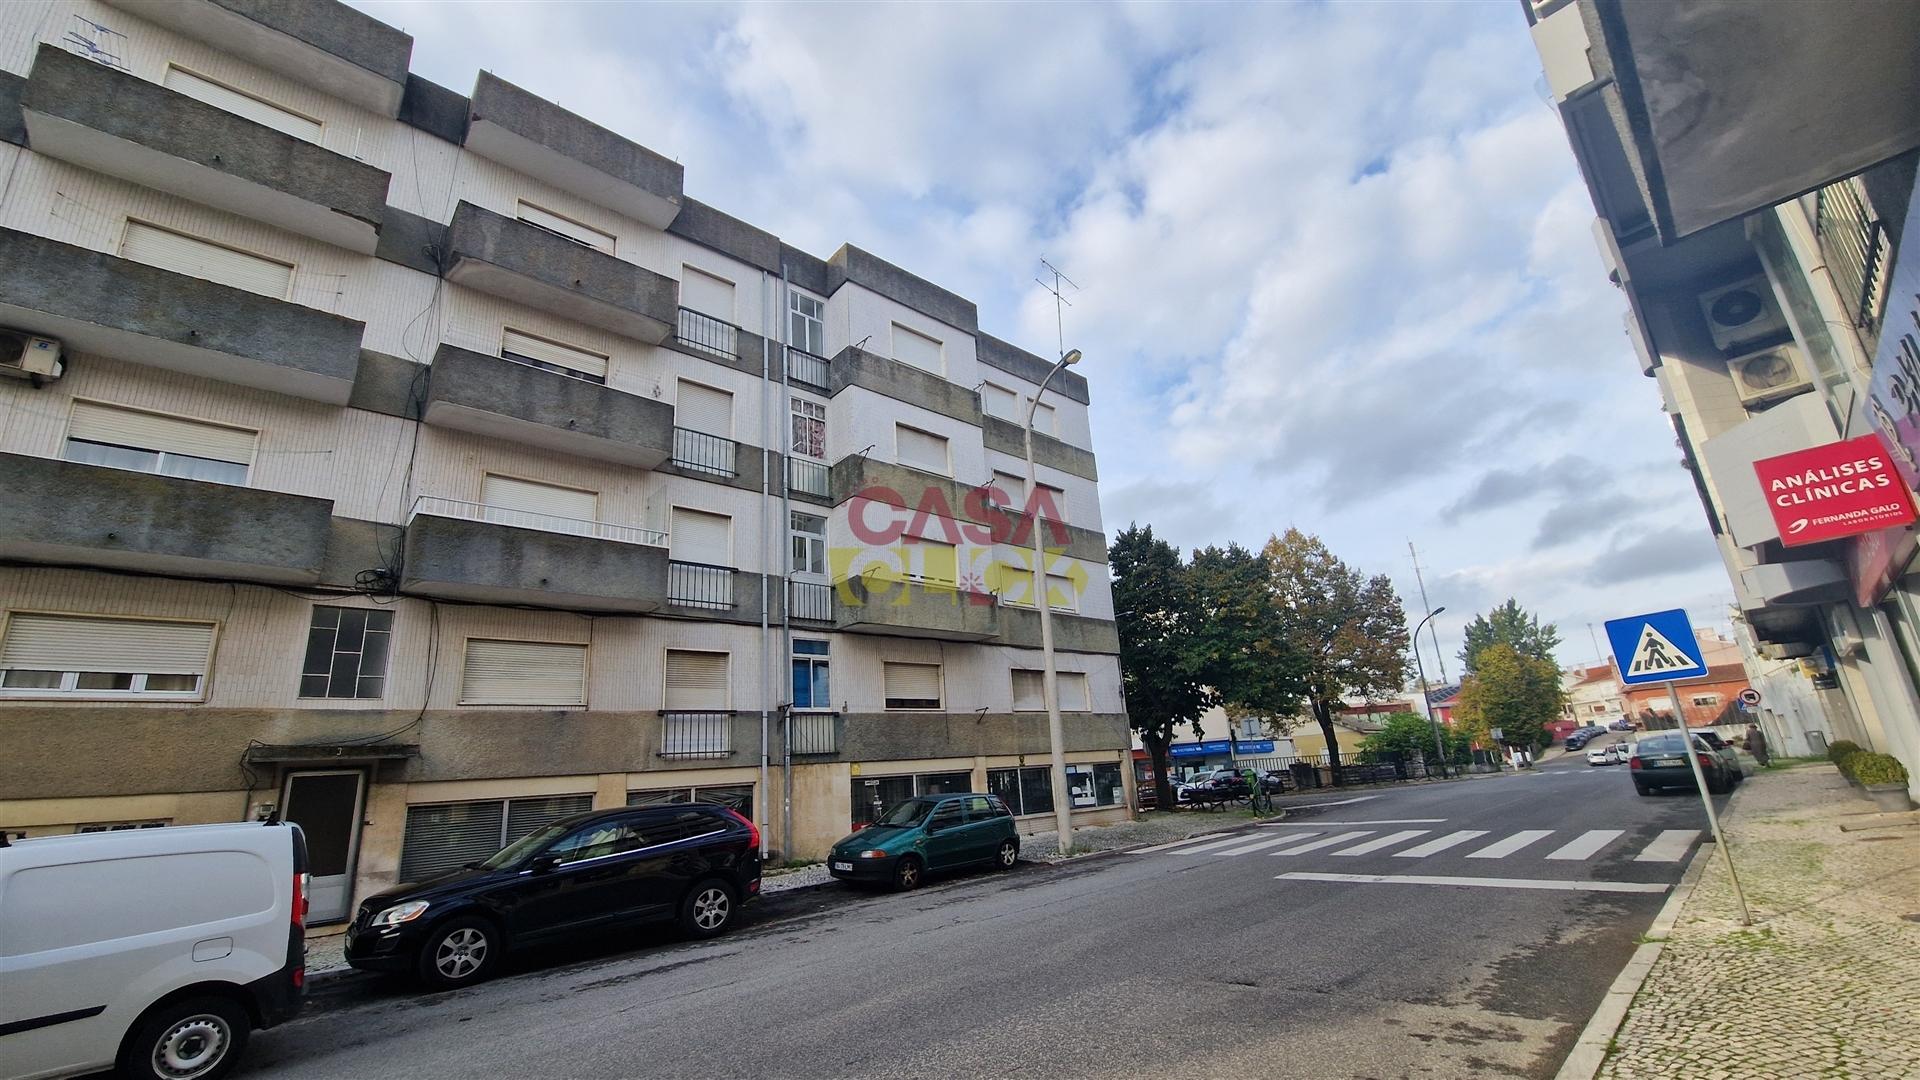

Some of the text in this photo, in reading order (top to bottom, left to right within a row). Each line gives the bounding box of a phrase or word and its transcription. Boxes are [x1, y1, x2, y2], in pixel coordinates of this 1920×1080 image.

[1771, 456, 1883, 492] ANÁLISES
[1776, 473, 1890, 507] CLÍNICAS
[1812, 503, 1900, 526] FERNANDA GALO
